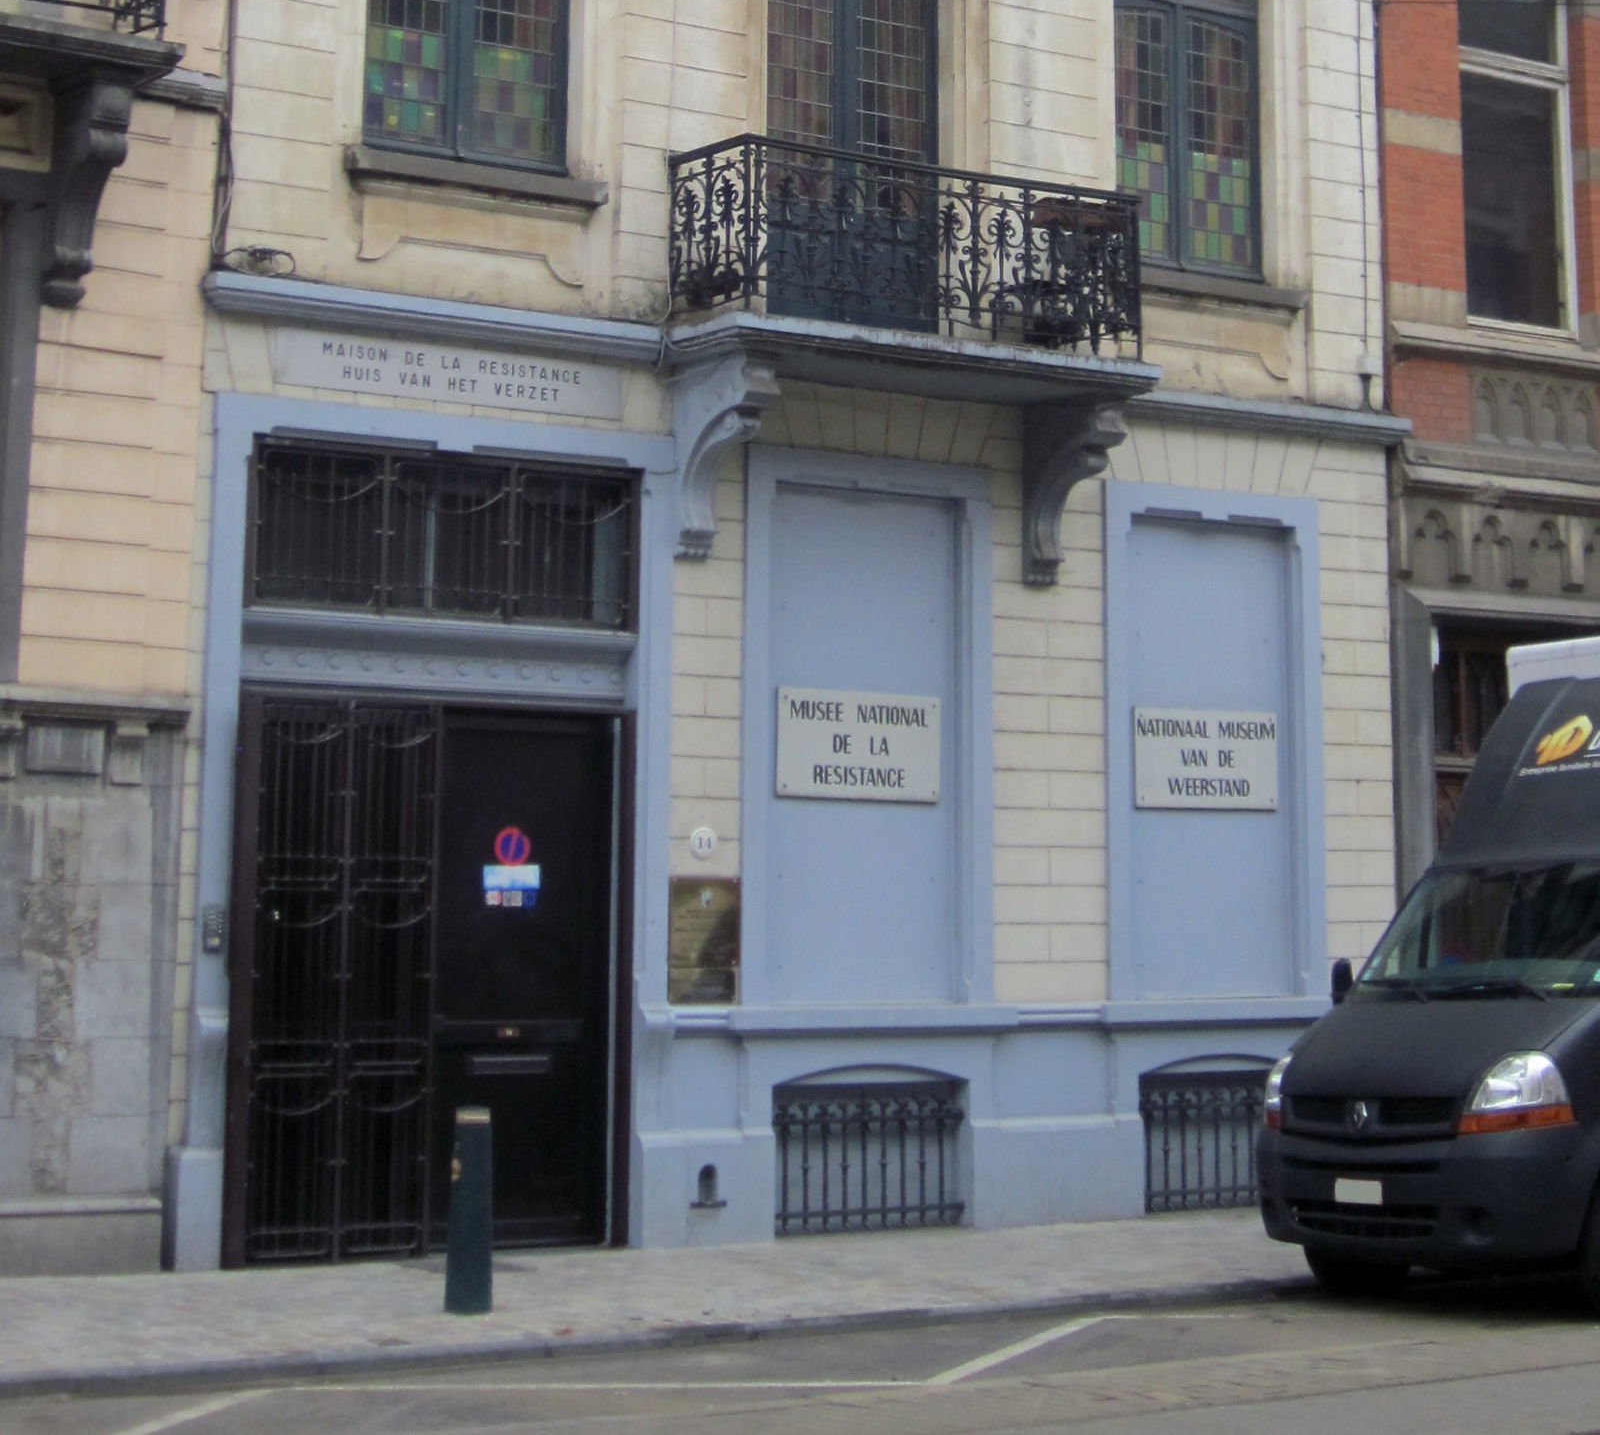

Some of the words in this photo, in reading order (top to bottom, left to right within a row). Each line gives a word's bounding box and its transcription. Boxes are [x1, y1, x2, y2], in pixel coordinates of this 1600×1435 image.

[322, 341, 387, 361] MAISON
[404, 351, 424, 367] DE
[441, 355, 461, 370] LA
[478, 360, 582, 385] RESISTANCE
[342, 365, 381, 383] HUIS
[399, 372, 431, 388] VAN
[447, 377, 478, 393] HET
[494, 383, 560, 402] VERZET
[789, 699, 844, 722] MUSEE
[856, 704, 929, 728] NATIONAL
[1136, 718, 1210, 739] NATIONAAL
[1218, 721, 1275, 740] MUSEUM
[832, 733, 851, 754] DE
[869, 736, 889, 756] LA
[1181, 749, 1208, 767] VAN
[1218, 750, 1235, 768] DE
[812, 764, 905, 788] RESISTANCE
[1167, 777, 1250, 798] WEERSTAND
[698, 836, 712, 850] 14
